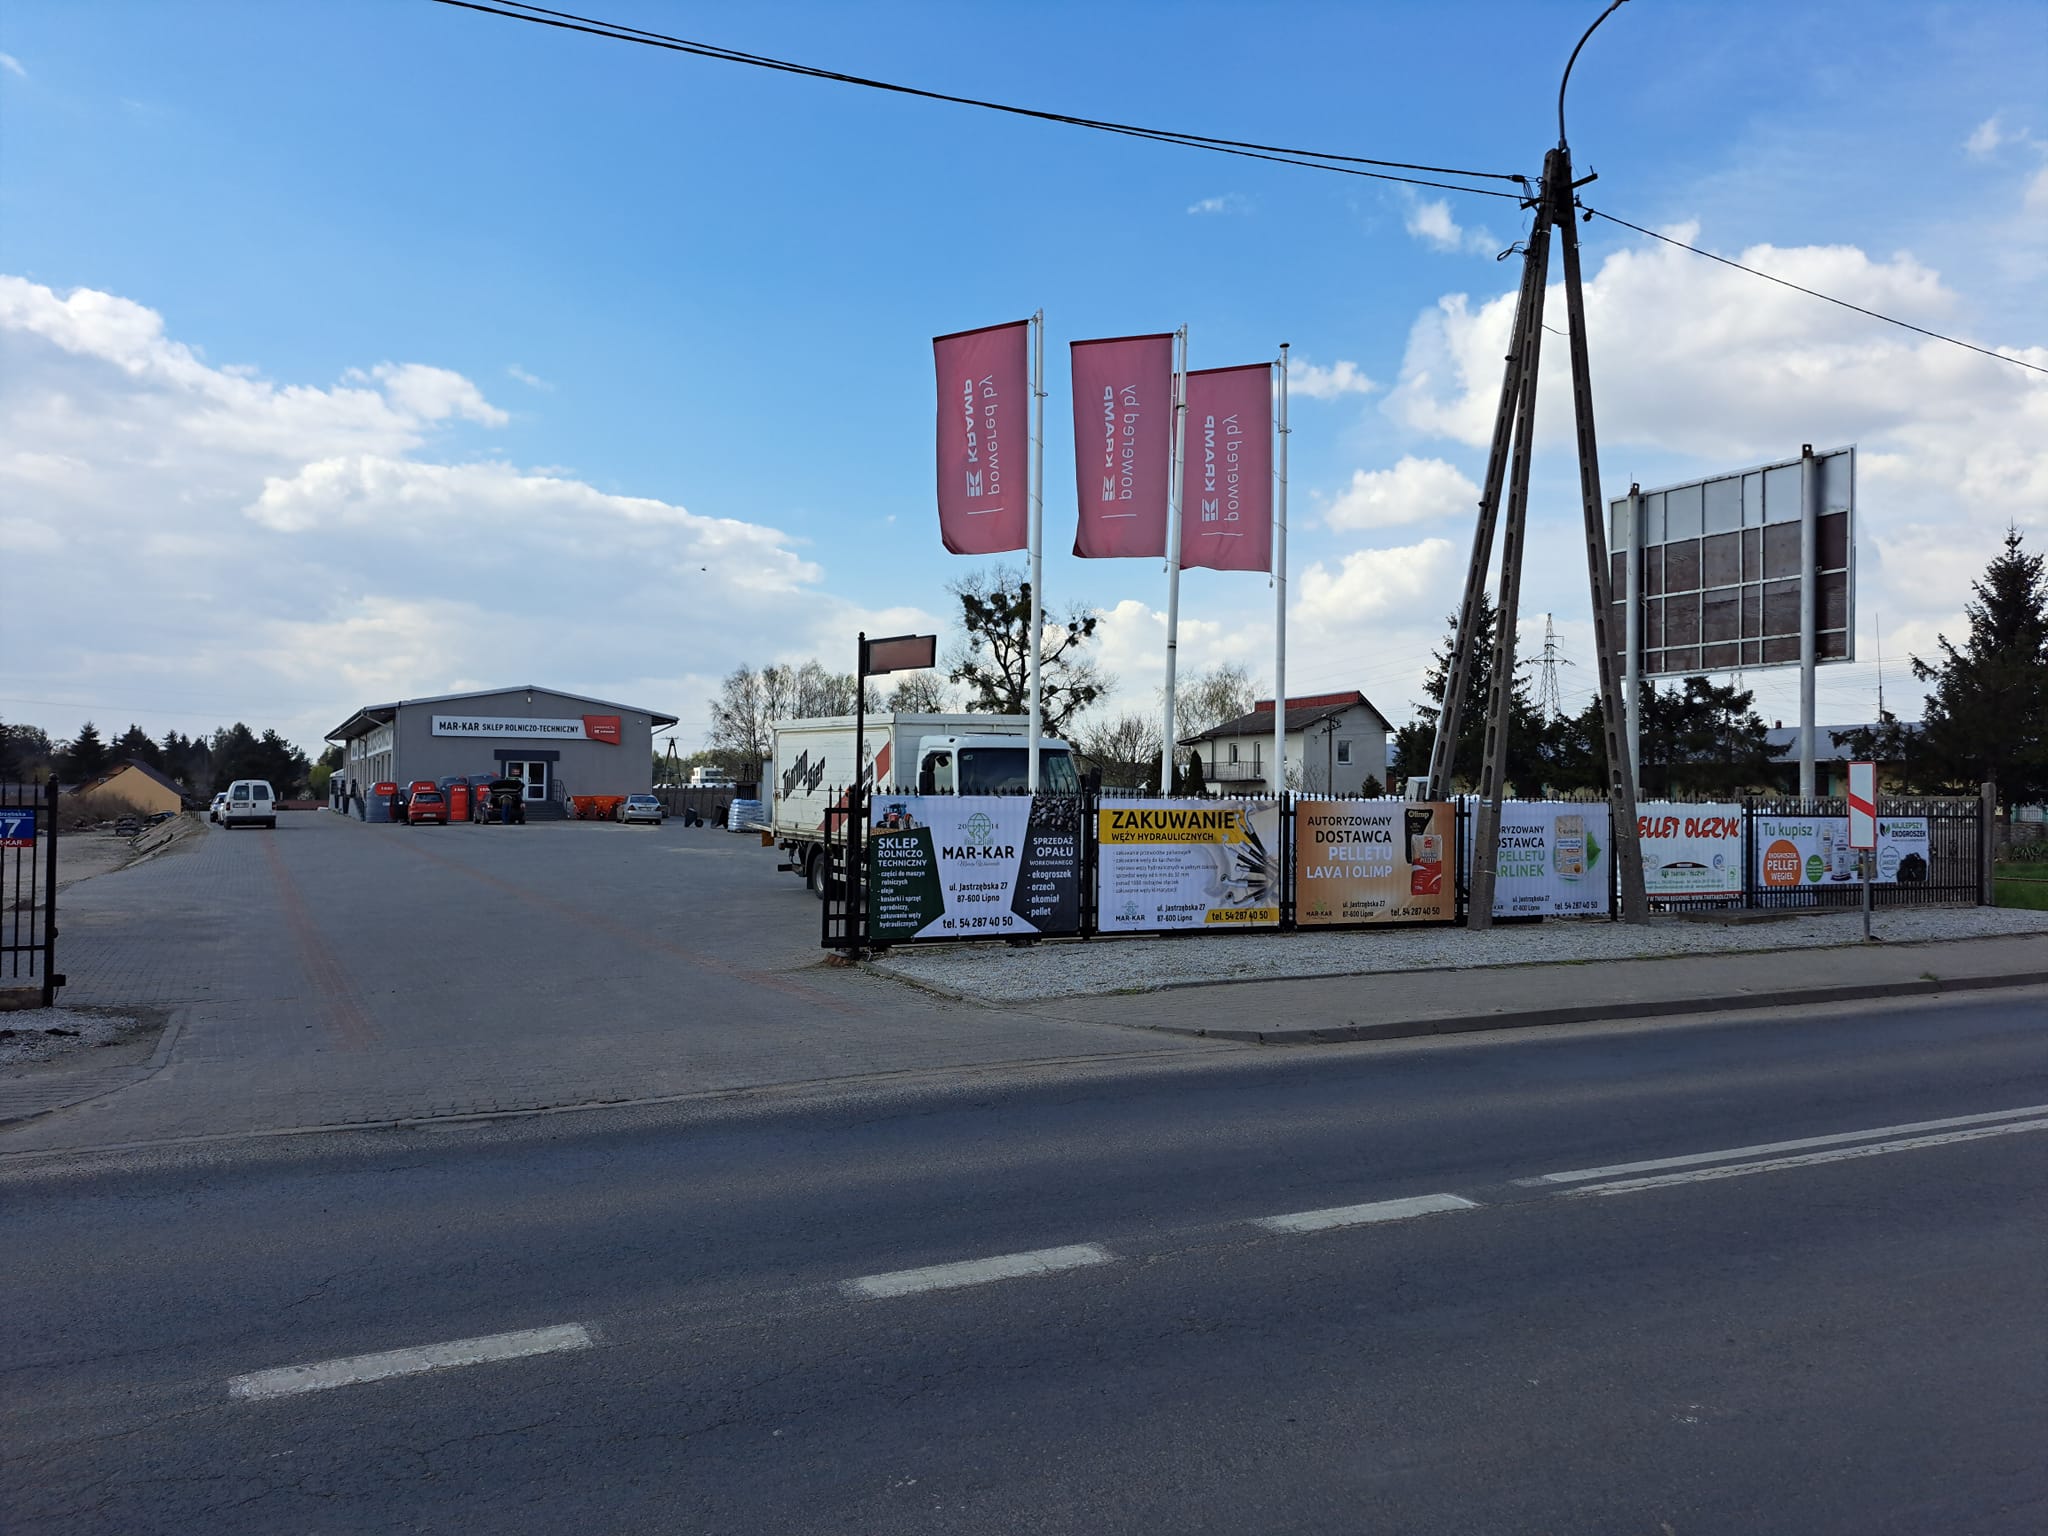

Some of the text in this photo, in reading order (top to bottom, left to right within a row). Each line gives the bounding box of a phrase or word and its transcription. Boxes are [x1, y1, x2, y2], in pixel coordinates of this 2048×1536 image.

[439, 722, 579, 733] MAR-KAR SKLEP ROLNICZO-TECHNICZNY
[1112, 811, 1234, 829] ZAKUWANIE
[1308, 817, 1392, 825] AUTORYZOWANY
[0, 819, 21, 838] 7
[1685, 817, 1739, 840] OLCZYK
[1763, 822, 1812, 840] Tu kupisz
[1112, 832, 1136, 842] WĘŻY
[1316, 831, 1392, 843] DOSTAWCA
[1892, 830, 1926, 838] EKOGROSZEK
[879, 838, 918, 849] SKLEP
[1033, 836, 1073, 845] SPRZEDAŻ
[879, 850, 923, 858] ROLNICZO
[943, 846, 1014, 859] MAR-KAR
[1037, 847, 1073, 856] OPAŁU
[1329, 846, 1392, 861] PELLETU
[1499, 850, 1545, 861] PELLETU
[878, 859, 927, 867] TECHNICZNY
[1767, 860, 1798, 870] PELLET
[1032, 870, 1072, 879] ekogroszek
[1307, 866, 1342, 878] LAVA
[1353, 866, 1392, 877] OLIMP
[959, 883, 999, 892] Jastrzębska
[1000, 882, 1008, 890] 27
[1032, 882, 1055, 891] orzech
[957, 894, 999, 903] 87-600 Lipno
[1031, 908, 1051, 917] pellet
[1165, 904, 1198, 912] Jastrzębska
[1391, 908, 1401, 916] tel.
[1212, 911, 1268, 920] tel. 54 287 40 50
[943, 917, 1013, 928] tel. 54 287 40 50
